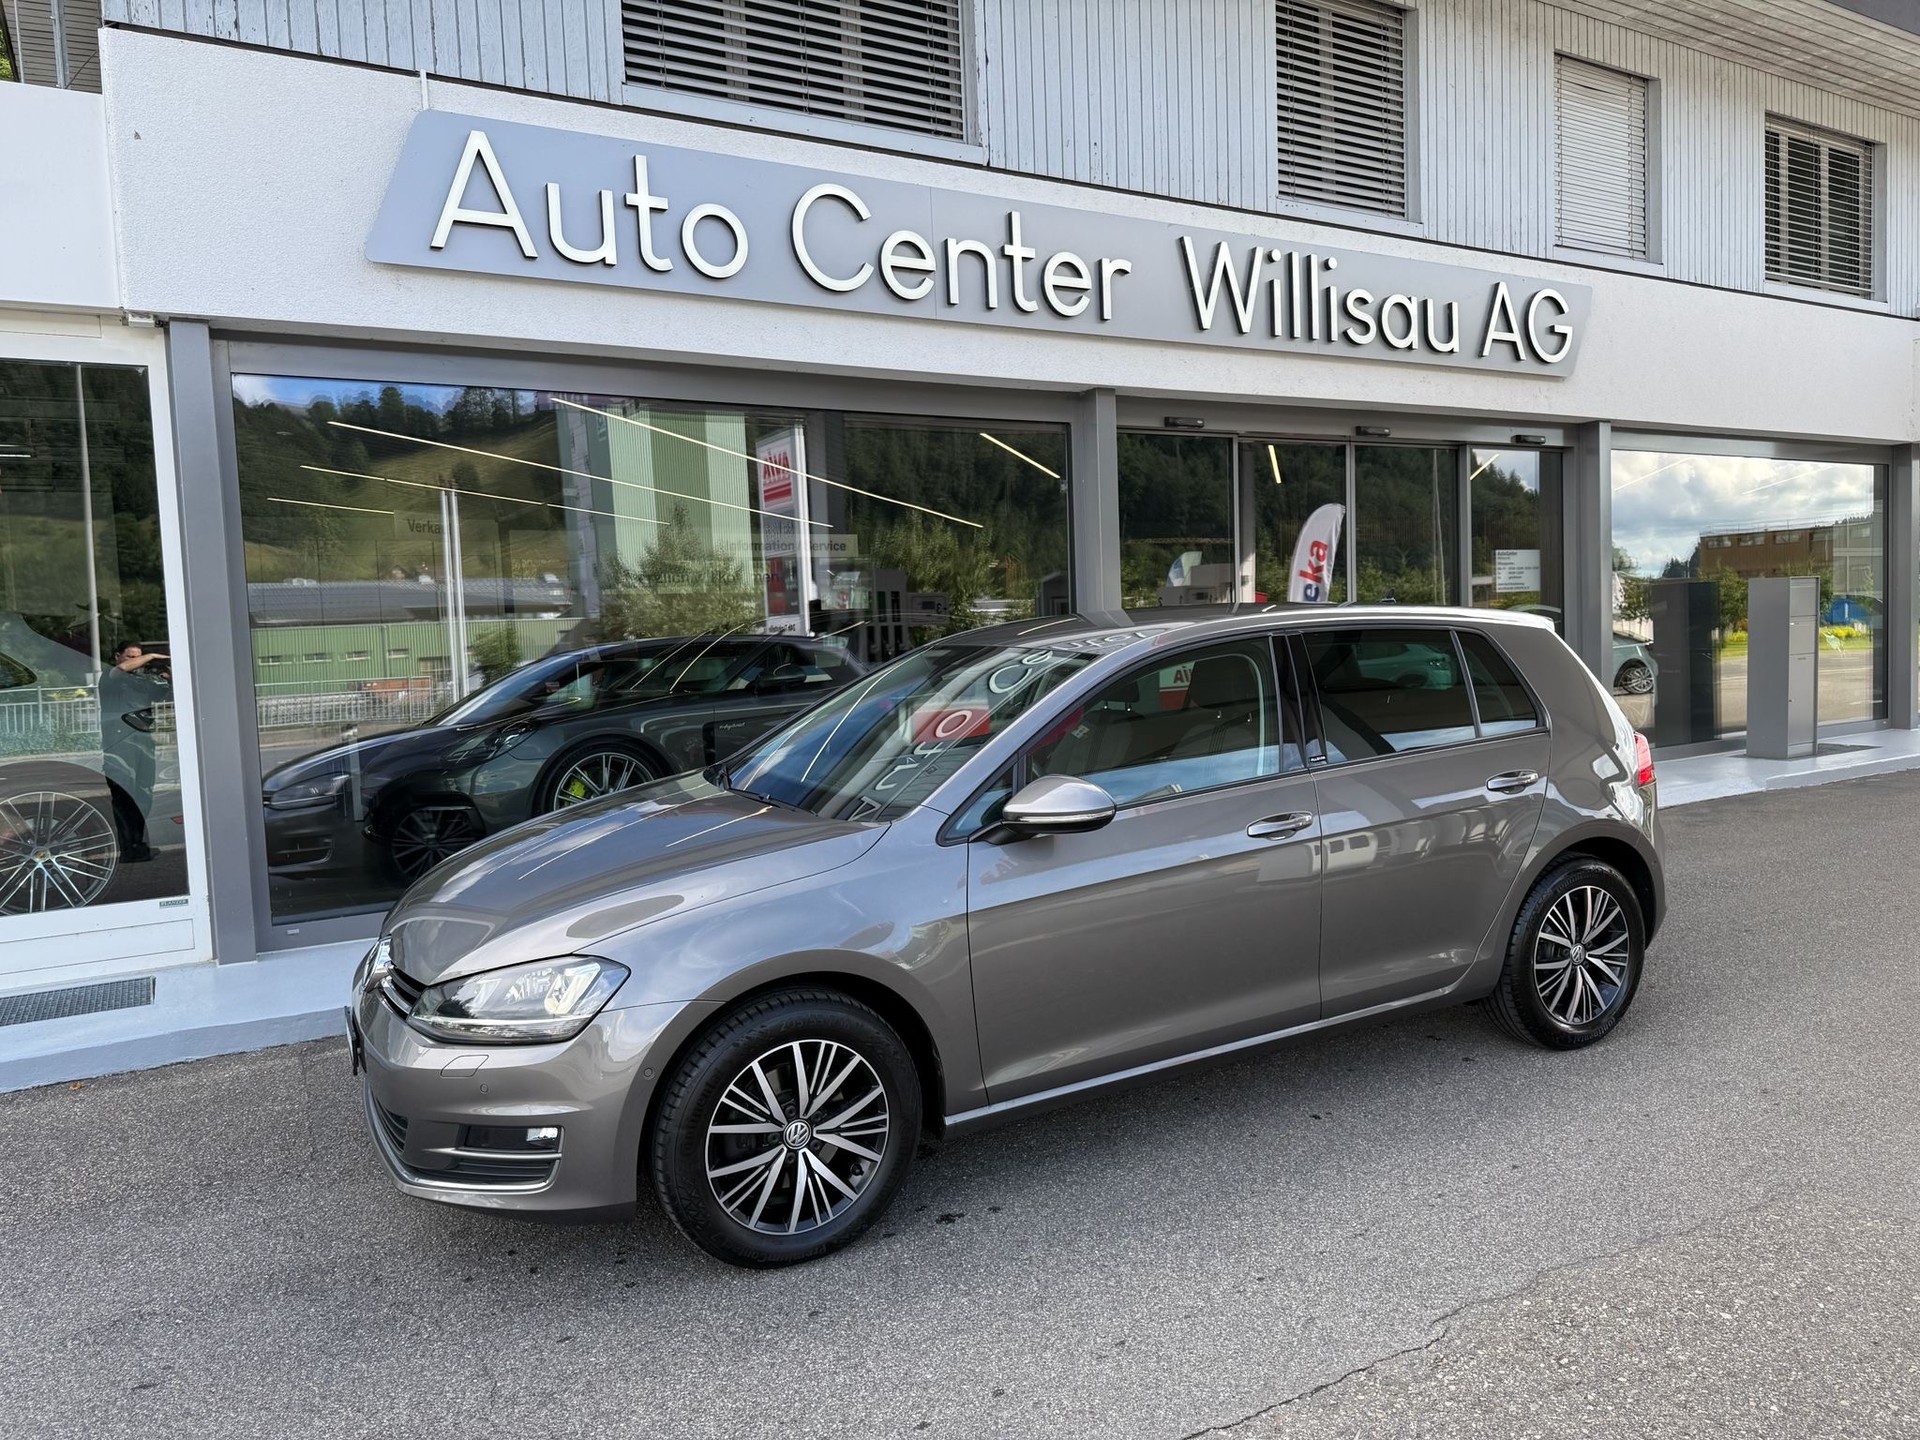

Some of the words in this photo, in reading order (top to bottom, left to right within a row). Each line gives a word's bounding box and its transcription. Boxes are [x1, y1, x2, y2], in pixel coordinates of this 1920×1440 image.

[430, 130, 749, 280] Auto
[790, 183, 1132, 320] Center
[1176, 235, 1460, 354] Willisau
[1480, 281, 1574, 364] AG
[1299, 540, 1328, 602] eka
